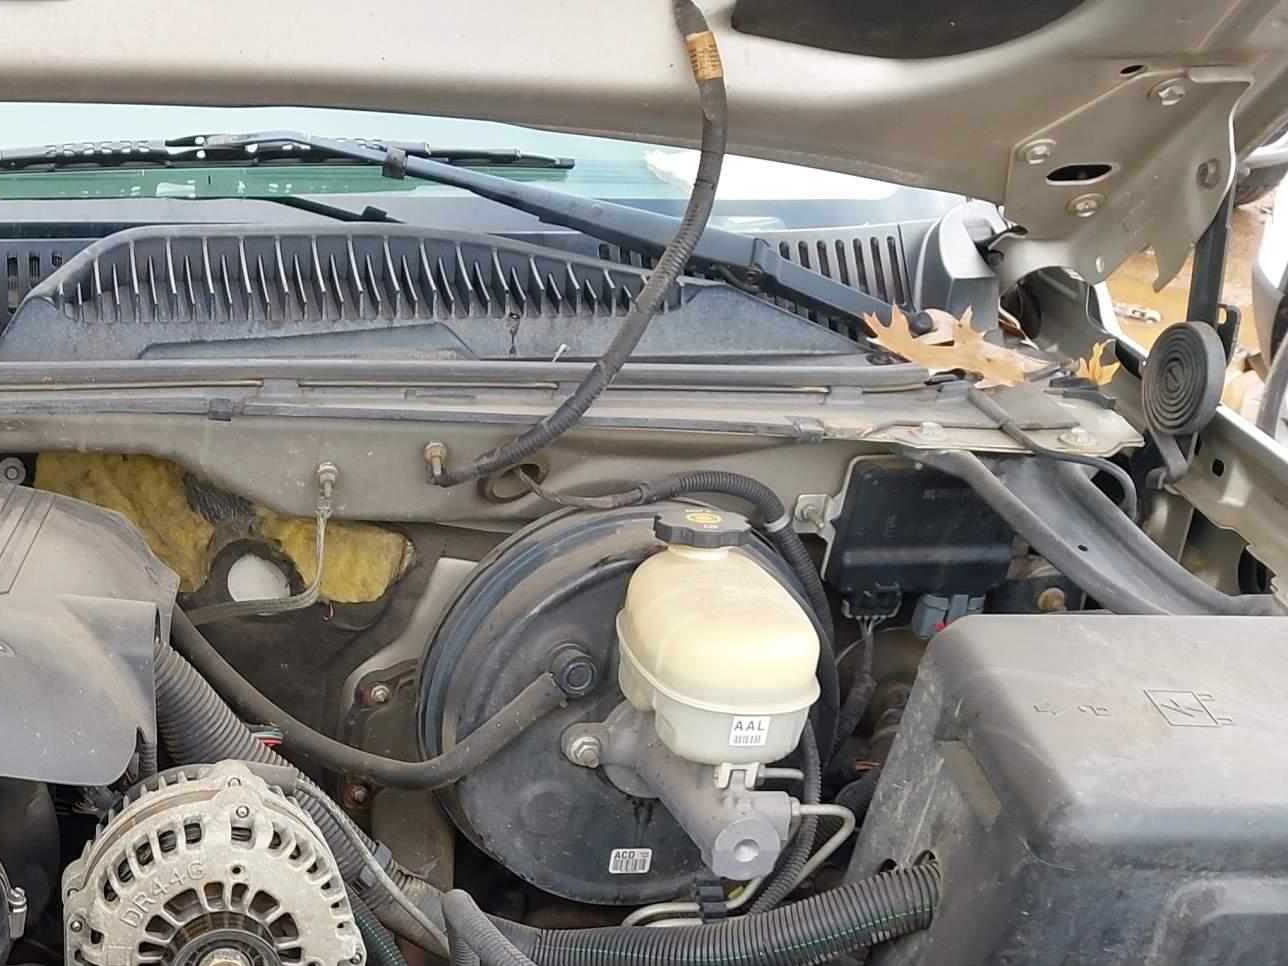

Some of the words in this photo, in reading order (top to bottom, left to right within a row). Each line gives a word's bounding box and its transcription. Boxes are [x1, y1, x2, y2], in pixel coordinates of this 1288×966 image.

[733, 719, 766, 732] AAL
[614, 850, 636, 860] ACD
[120, 862, 207, 929] DR44G
